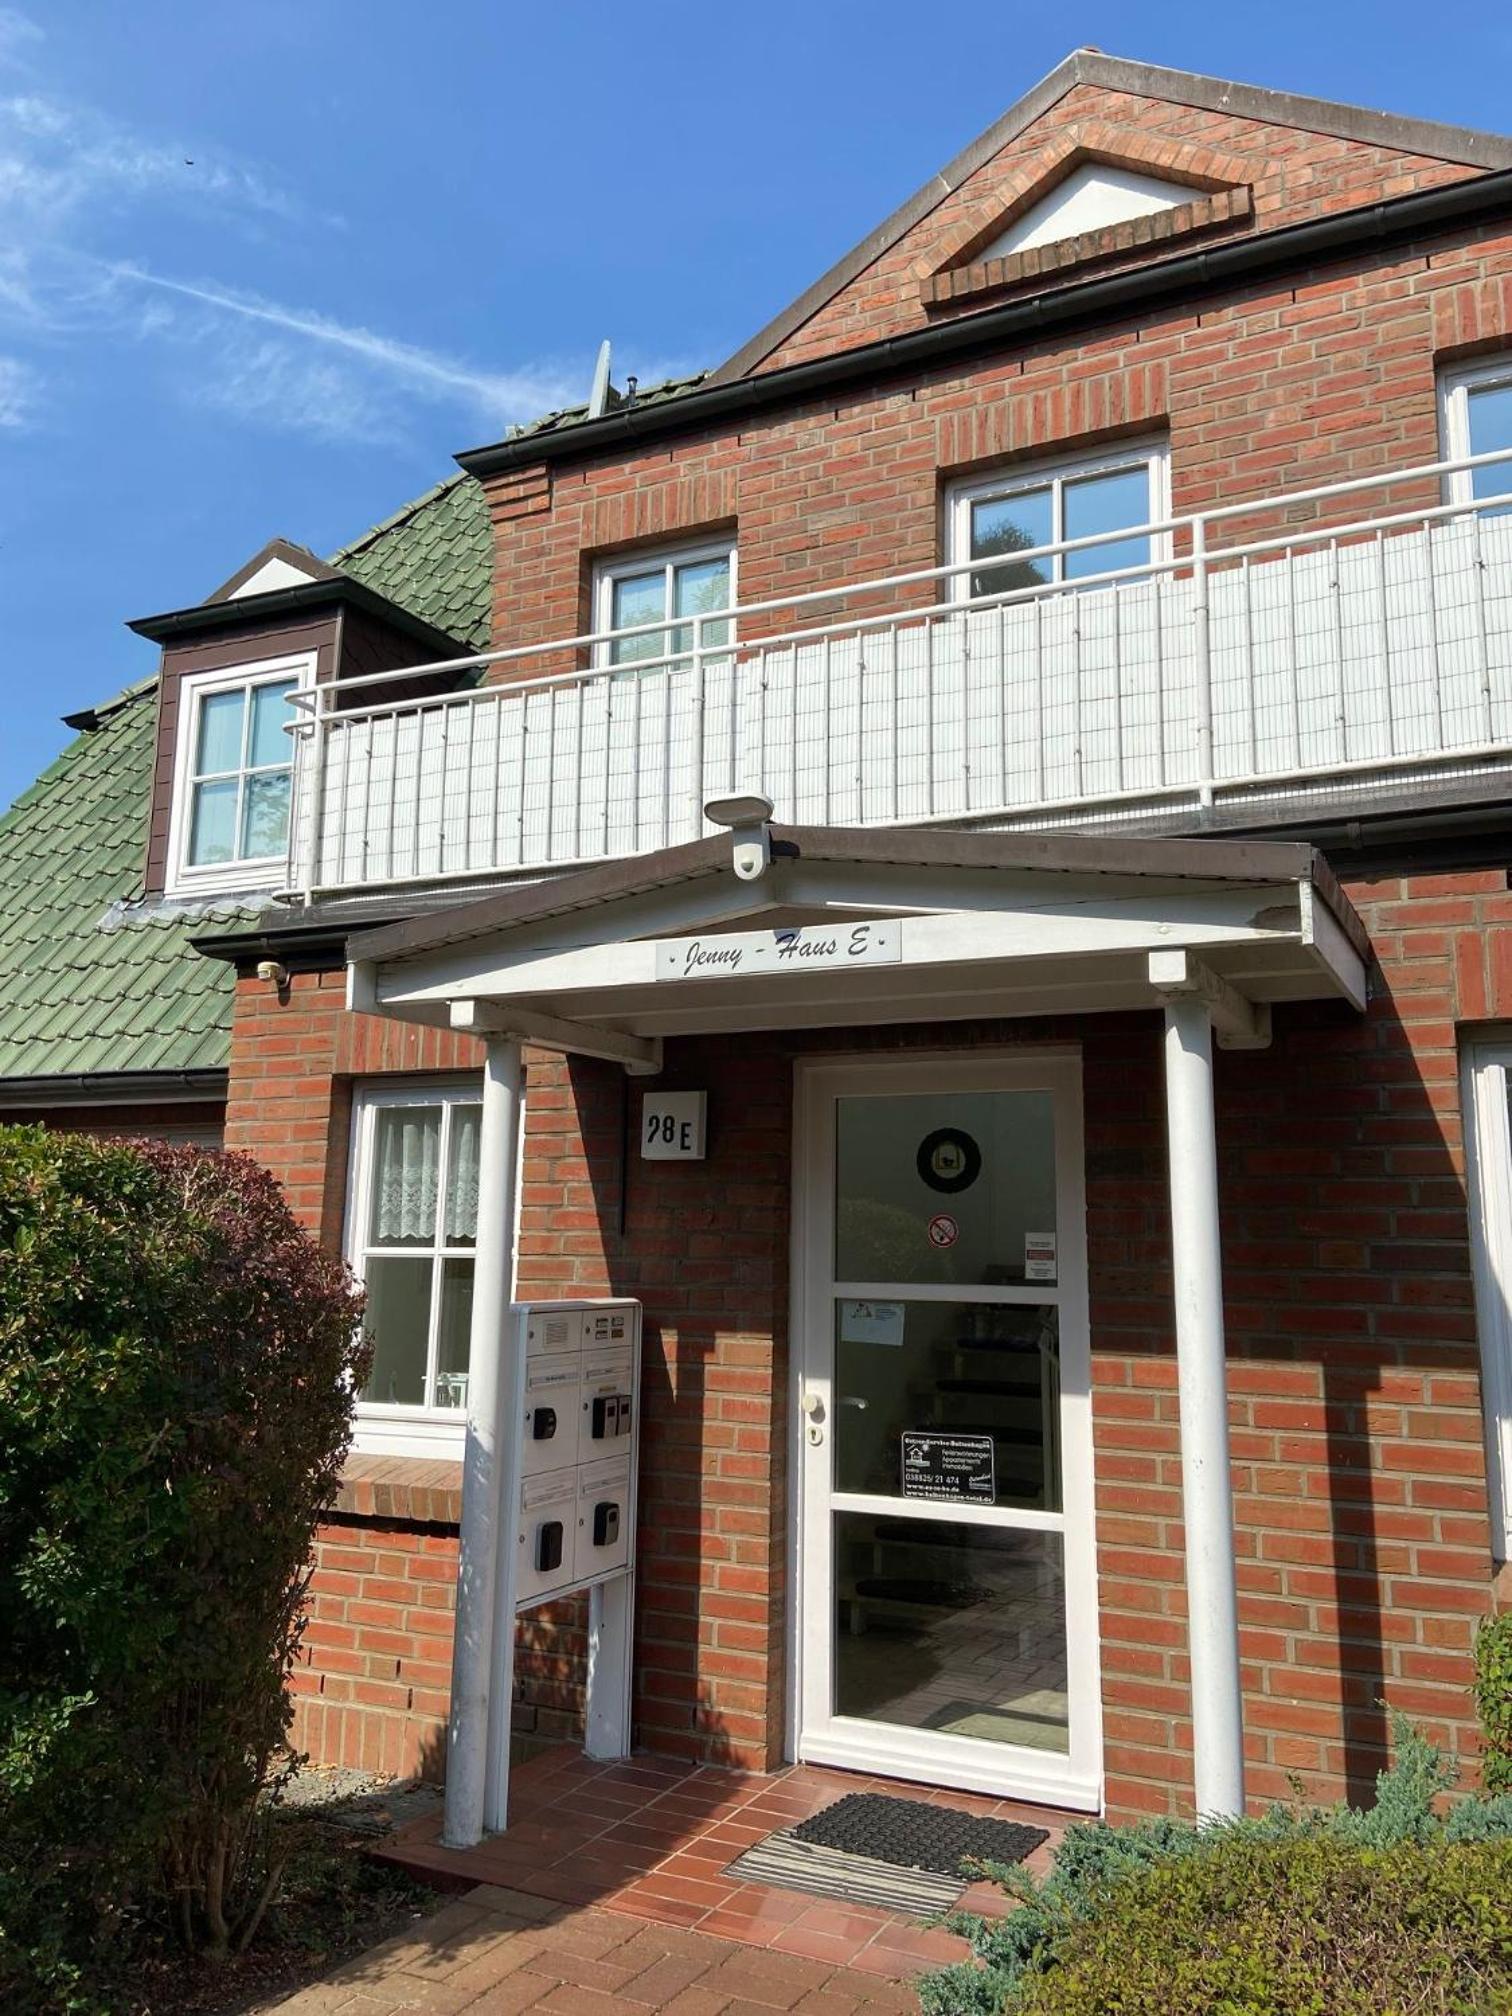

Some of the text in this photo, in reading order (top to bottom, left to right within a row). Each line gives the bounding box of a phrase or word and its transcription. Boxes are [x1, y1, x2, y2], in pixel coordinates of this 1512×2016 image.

[684, 942, 743, 976] Jenny
[775, 933, 838, 960] Haus
[848, 926, 871, 955] E
